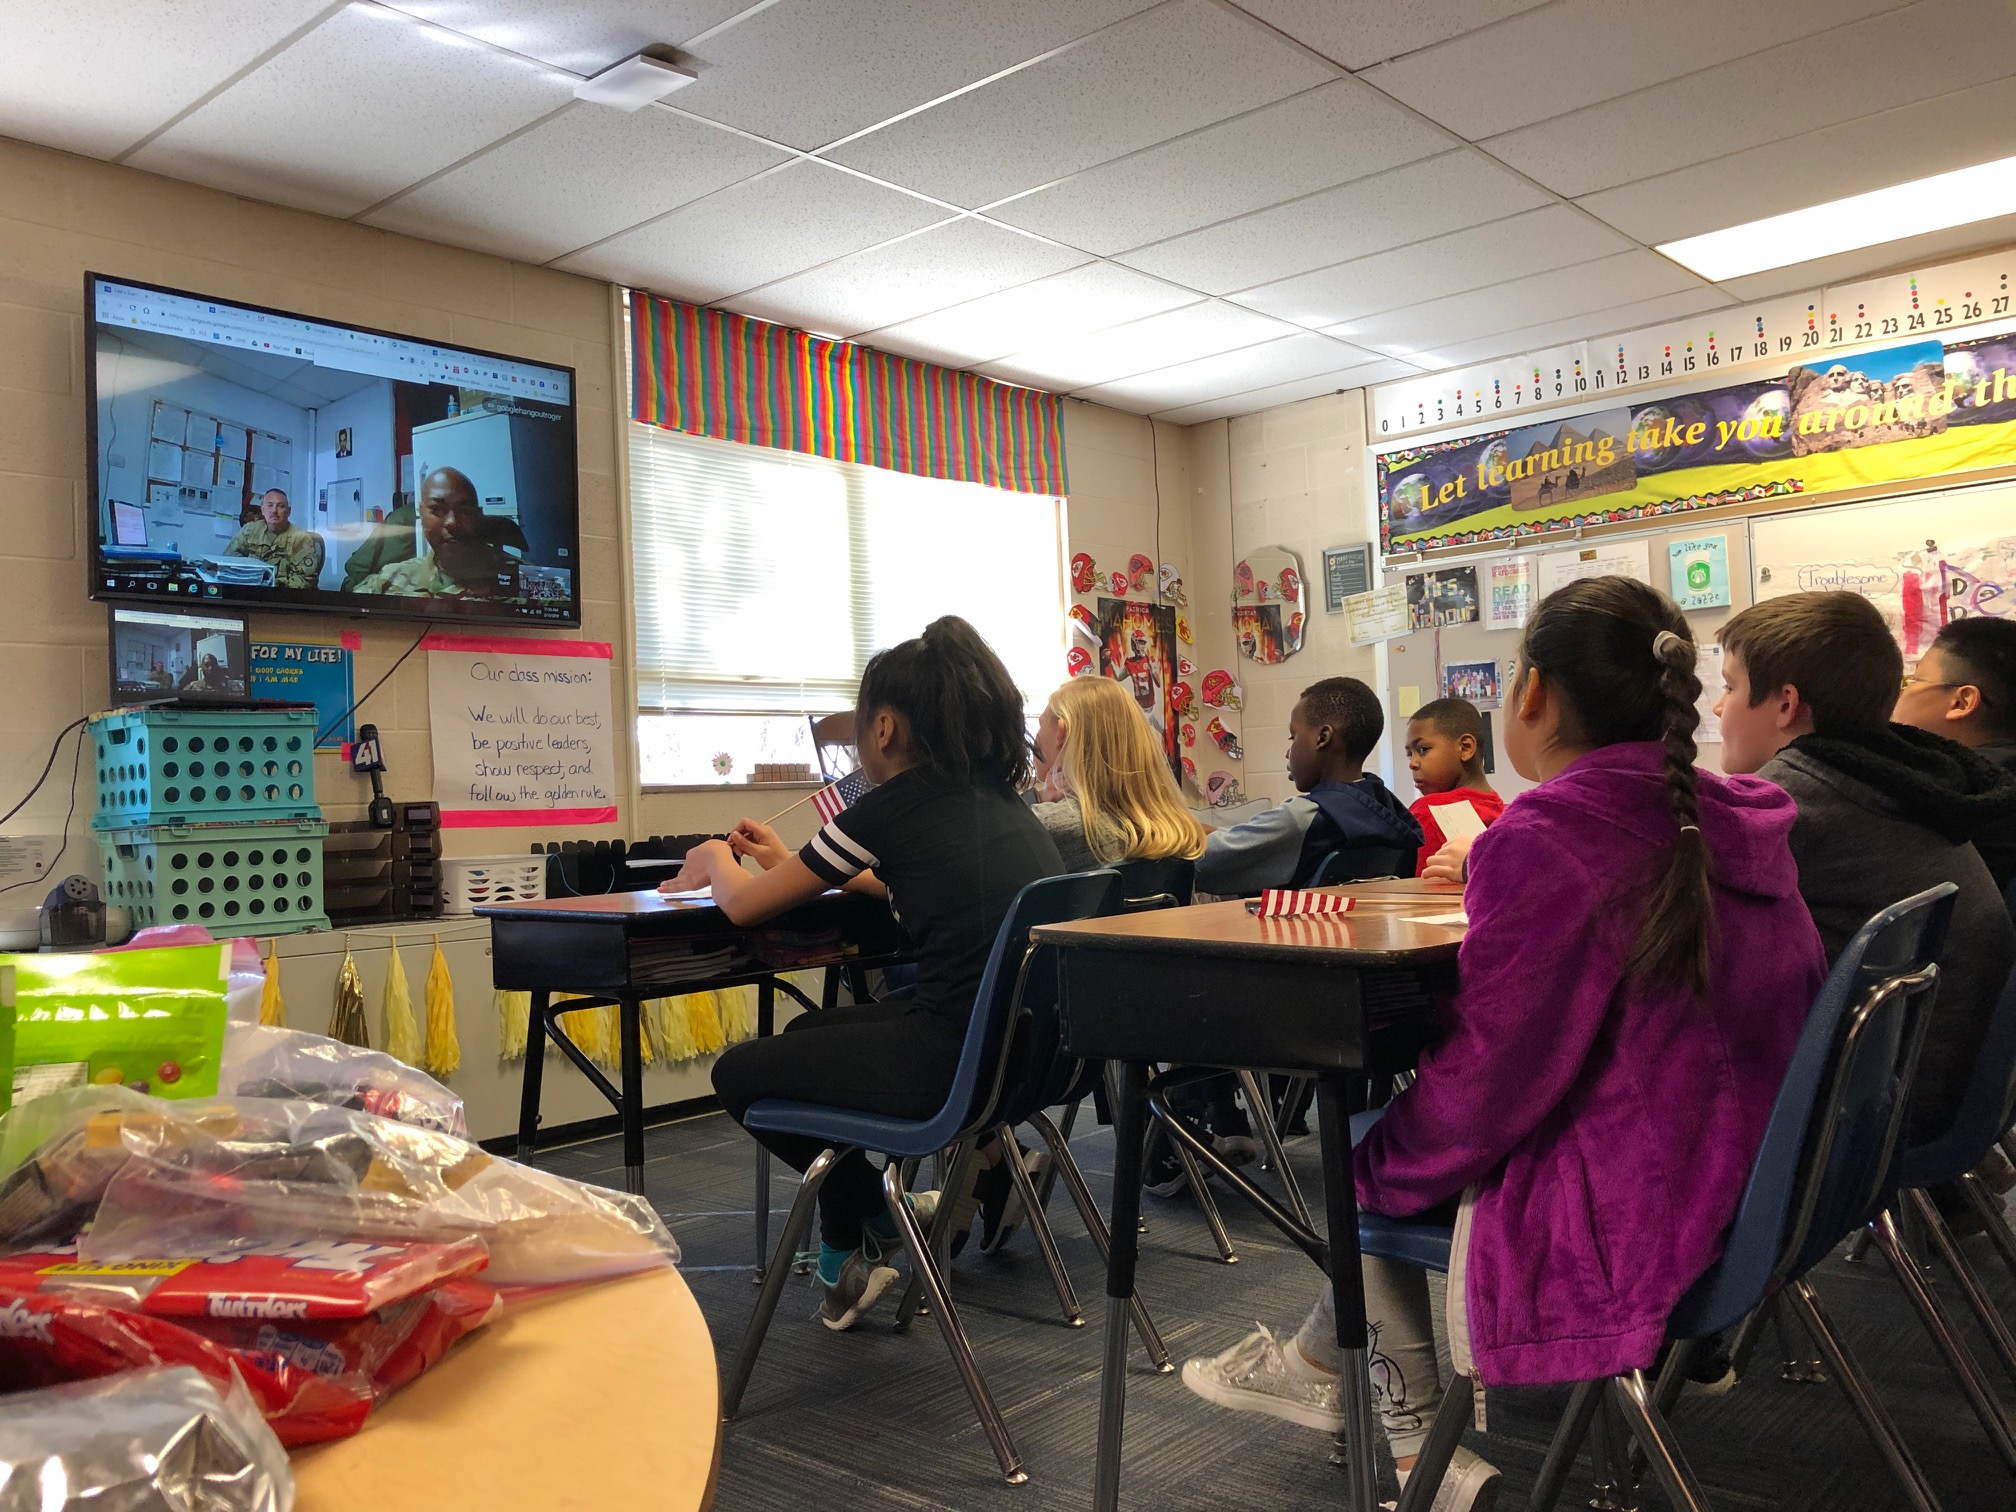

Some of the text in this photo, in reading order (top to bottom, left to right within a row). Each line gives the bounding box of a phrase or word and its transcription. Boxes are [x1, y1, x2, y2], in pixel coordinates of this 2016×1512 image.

[1381, 419, 1389, 432] 0
[1418, 412, 1425, 424] 2
[1437, 409, 1444, 421] 3
[1456, 404, 1463, 417] 4
[1475, 400, 1482, 413] 5
[1495, 396, 1502, 409] 6
[1515, 392, 1522, 404] 7
[1534, 388, 1542, 400] 8
[1555, 383, 1563, 396] 9
[1574, 379, 1587, 392] 10
[1595, 375, 1604, 390] 11
[1616, 370, 1628, 385] 12
[1638, 366, 1650, 380] 13
[1660, 361, 1673, 375] 14
[1684, 357, 1696, 371] 15
[1707, 352, 1720, 367] 16
[1730, 347, 1743, 361] 17
[1754, 342, 1768, 357] 18
[1779, 337, 1793, 352] 19
[1802, 331, 1820, 348] 20
[1829, 328, 1844, 343] 21
[1854, 323, 1873, 339] 22
[1881, 318, 1899, 335] 23
[1907, 313, 1926, 331] 24
[1934, 307, 1953, 325] 25
[1962, 302, 1982, 320] 26
[1992, 296, 2010, 314] 27
[1419, 368, 2016, 511] Let learning take you around th
[1684, 542, 1701, 552] like
[1802, 569, 1887, 588] Troublesome
[1492, 584, 1531, 597] READ
[1126, 605, 1150, 614] PATRICK
[1102, 613, 1175, 634] MAHOMES
[251, 645, 342, 663] FOR MY LIFE!
[470, 662, 593, 684] Our class mission:
[468, 705, 602, 730] We will do our best,
[471, 732, 592, 758] be positive leaders,
[475, 759, 594, 780] show respect, and
[469, 783, 606, 808] follow the golden rule.
